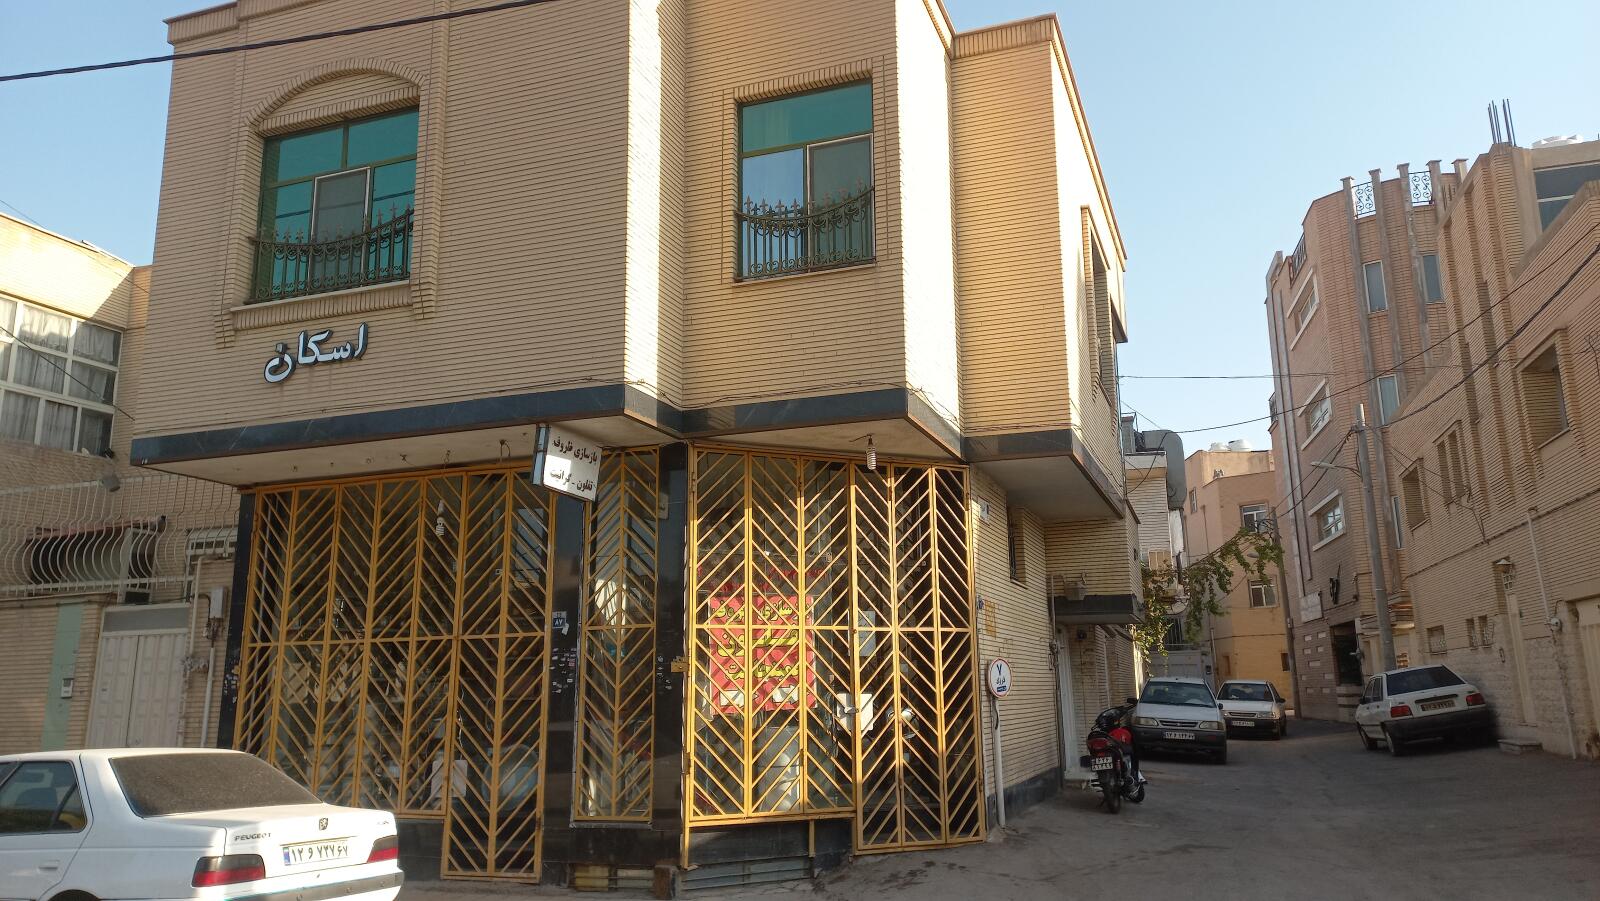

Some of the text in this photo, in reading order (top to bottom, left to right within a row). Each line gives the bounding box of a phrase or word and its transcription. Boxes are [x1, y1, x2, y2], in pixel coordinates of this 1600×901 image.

[264, 321, 368, 383] اسکان
[552, 436, 573, 454] ظروف
[233, 832, 272, 842] PEUGEOT
